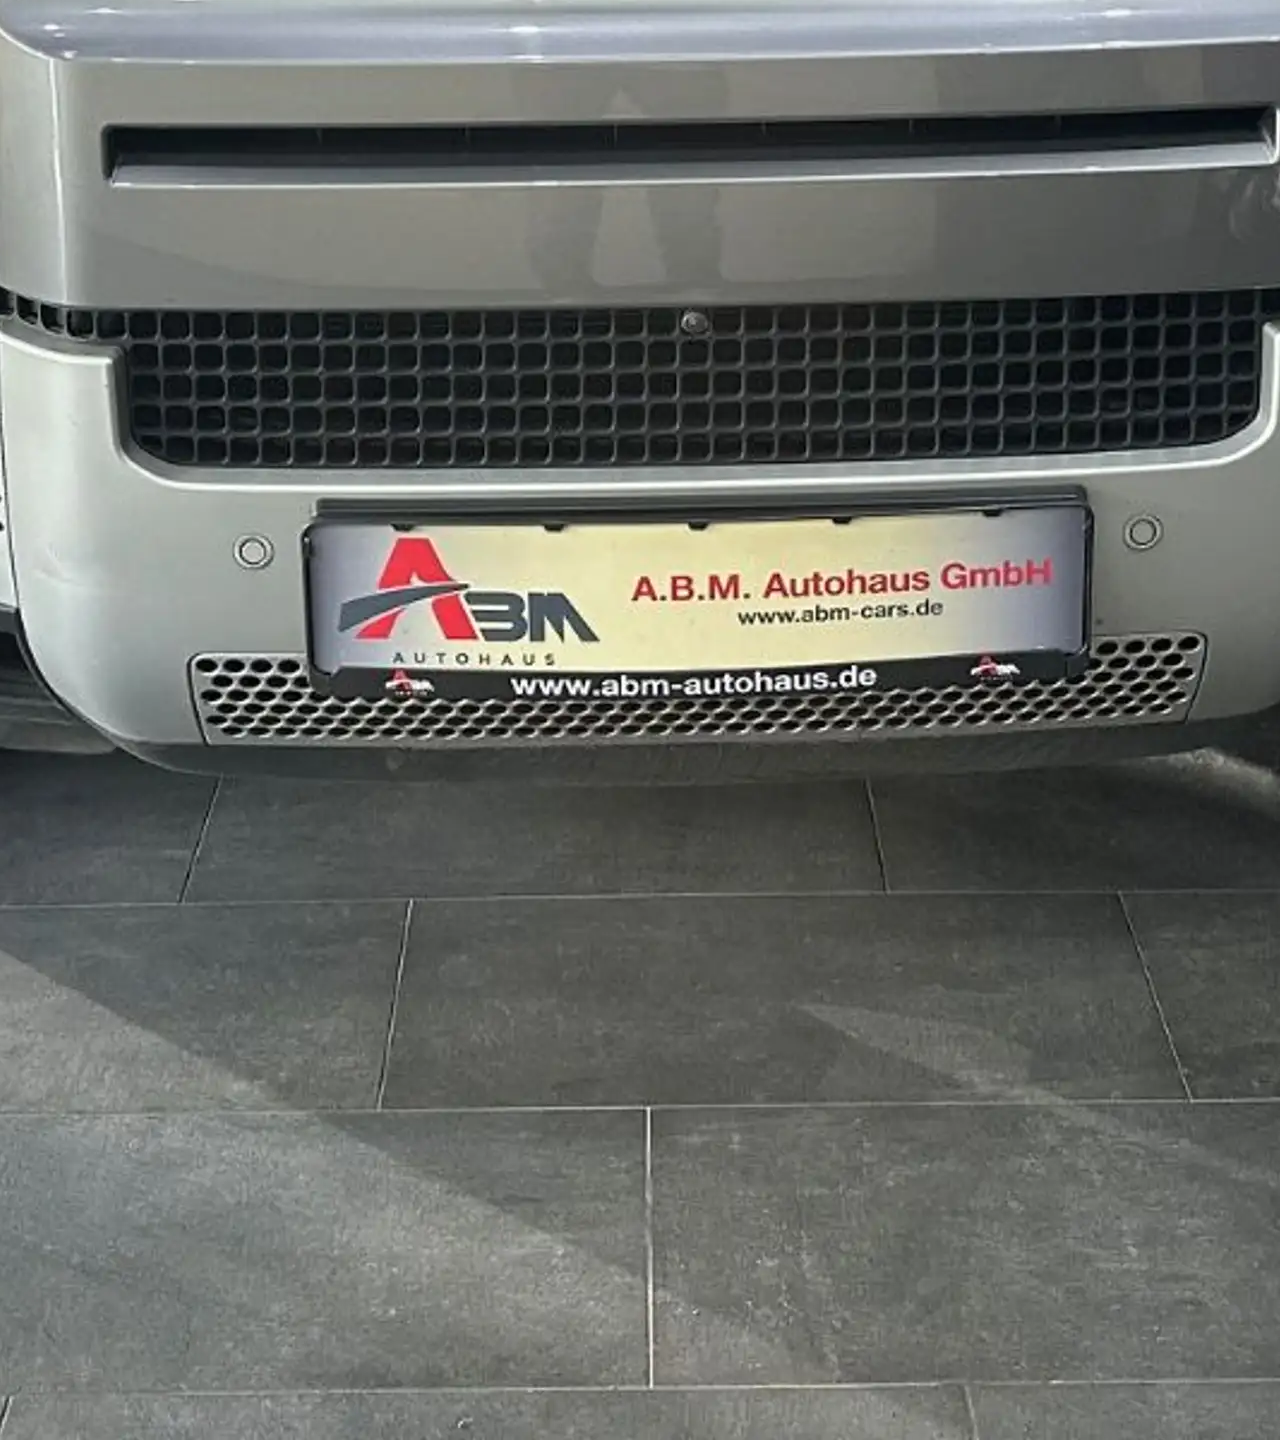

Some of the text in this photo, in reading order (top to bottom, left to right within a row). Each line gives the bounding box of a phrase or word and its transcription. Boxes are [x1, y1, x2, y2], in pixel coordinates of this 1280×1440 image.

[337, 536, 601, 643] ABM
[631, 557, 1053, 602] A.B.M. Autohaus GmbH
[737, 597, 944, 626] www.abm-cars.de
[391, 651, 556, 666] AUTOHAUS
[510, 665, 877, 698] www.abm-autohaus.de
